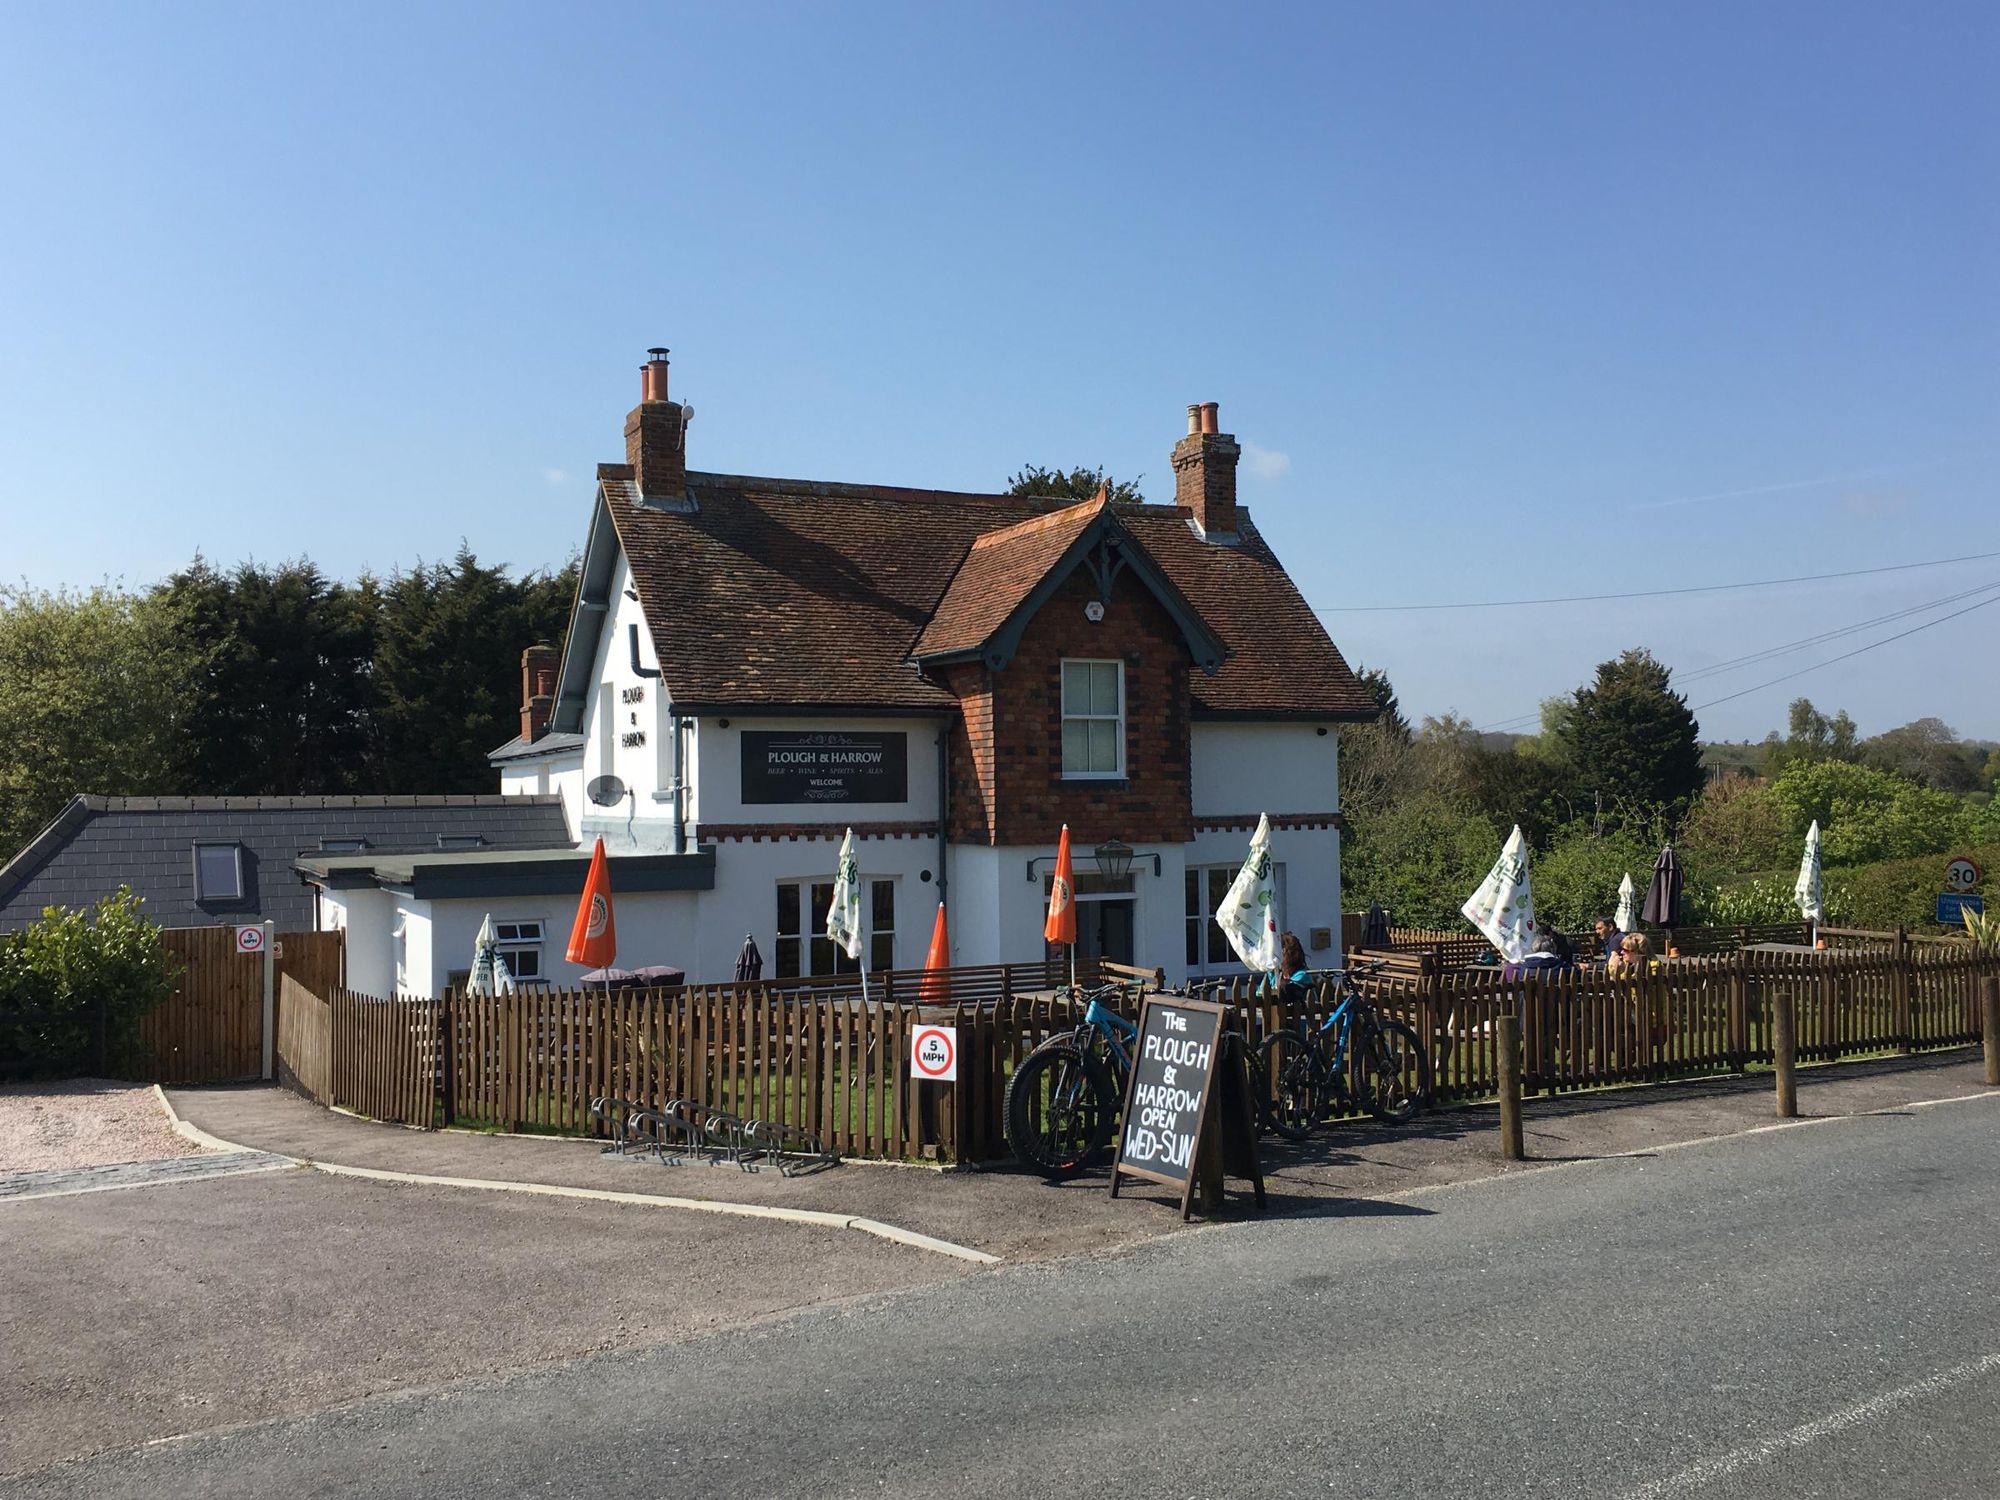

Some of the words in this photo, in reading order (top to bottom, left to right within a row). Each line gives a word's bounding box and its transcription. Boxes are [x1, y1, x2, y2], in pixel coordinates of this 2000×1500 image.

[622, 686, 645, 705] PLOUGH
[631, 711, 637, 726] &
[622, 731, 646, 748] HARROW
[768, 752, 816, 763] PLOUGH
[819, 752, 830, 763] &
[831, 752, 882, 763] HARROW
[767, 767, 786, 775] BEER
[798, 767, 817, 775] WINE
[809, 778, 844, 786] WELCOME
[1948, 868, 1975, 884] 30
[1161, 1011, 1187, 1032] THE
[929, 1040, 938, 1051] 5
[1144, 1035, 1211, 1071] PLOUGH
[922, 1052, 945, 1063] MPH
[1162, 1064, 1178, 1086] &
[1135, 1082, 1202, 1113] HARROW
[1140, 1107, 1178, 1131] OPEN
[1124, 1123, 1196, 1169] WED-SUN
